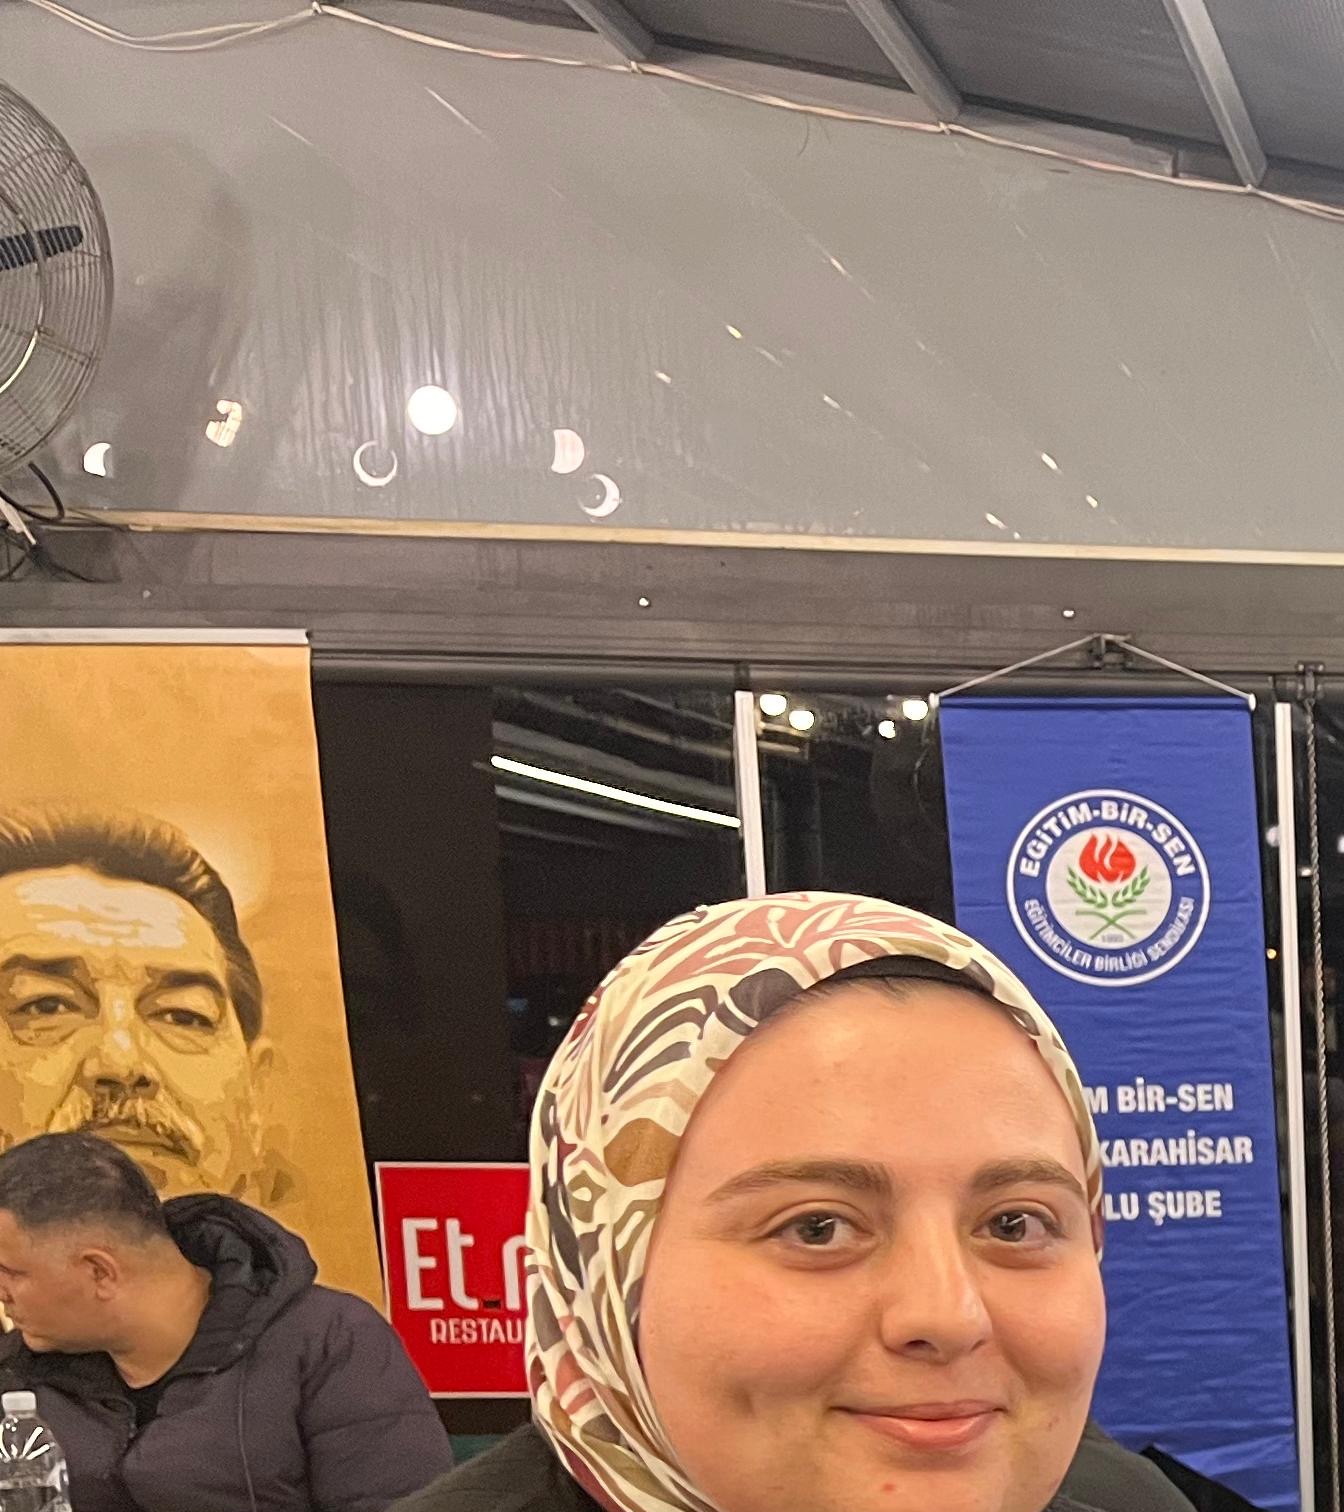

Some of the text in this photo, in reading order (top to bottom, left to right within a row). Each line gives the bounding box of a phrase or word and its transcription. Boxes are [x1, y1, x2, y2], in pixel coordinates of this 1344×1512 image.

[1117, 1077, 1234, 1113] BİR-SEN
[1102, 1190, 1222, 1226] LU ŞUBE
[430, 1317, 523, 1344] RESTAU
